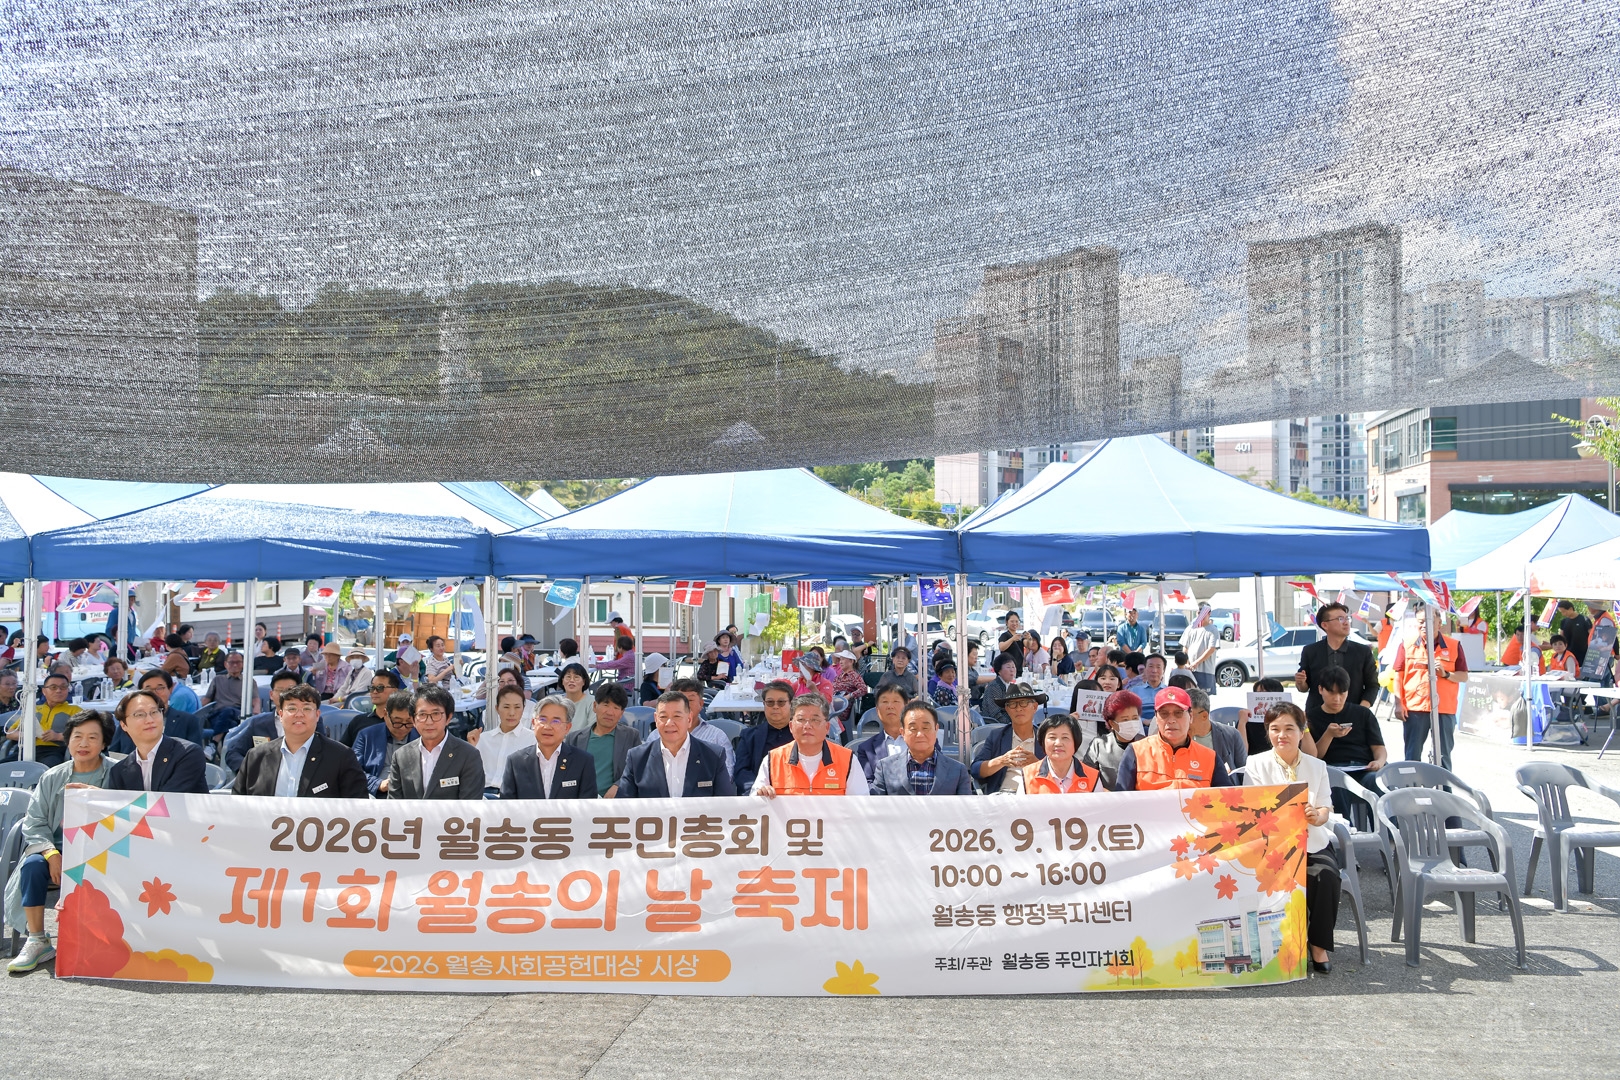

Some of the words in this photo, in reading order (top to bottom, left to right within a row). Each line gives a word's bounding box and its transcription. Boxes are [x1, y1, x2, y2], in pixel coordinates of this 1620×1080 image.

[1235, 442, 1251, 452] 401
[269, 816, 423, 859] 2026년
[436, 817, 574, 860] 월송동
[588, 814, 770, 859] 주민총회
[785, 818, 824, 857] 및
[929, 828, 1003, 854] 2026.
[1010, 819, 1043, 853] 9.
[1048, 817, 1144, 851] 19.(토)
[930, 864, 1003, 887] 10:00
[1036, 862, 1106, 885] 16:00
[218, 866, 398, 932] 제1회
[415, 869, 621, 934] 월송의
[645, 868, 713, 932] 날
[731, 866, 869, 932] 축제
[932, 904, 997, 927] 월송동
[1002, 900, 1132, 925] 행정복지센터
[372, 955, 439, 974] 2026
[650, 954, 700, 977] 시상
[934, 956, 993, 971] 주최/주관
[1001, 952, 1051, 970] 월송동
[1055, 949, 1135, 969] 주민자치회
